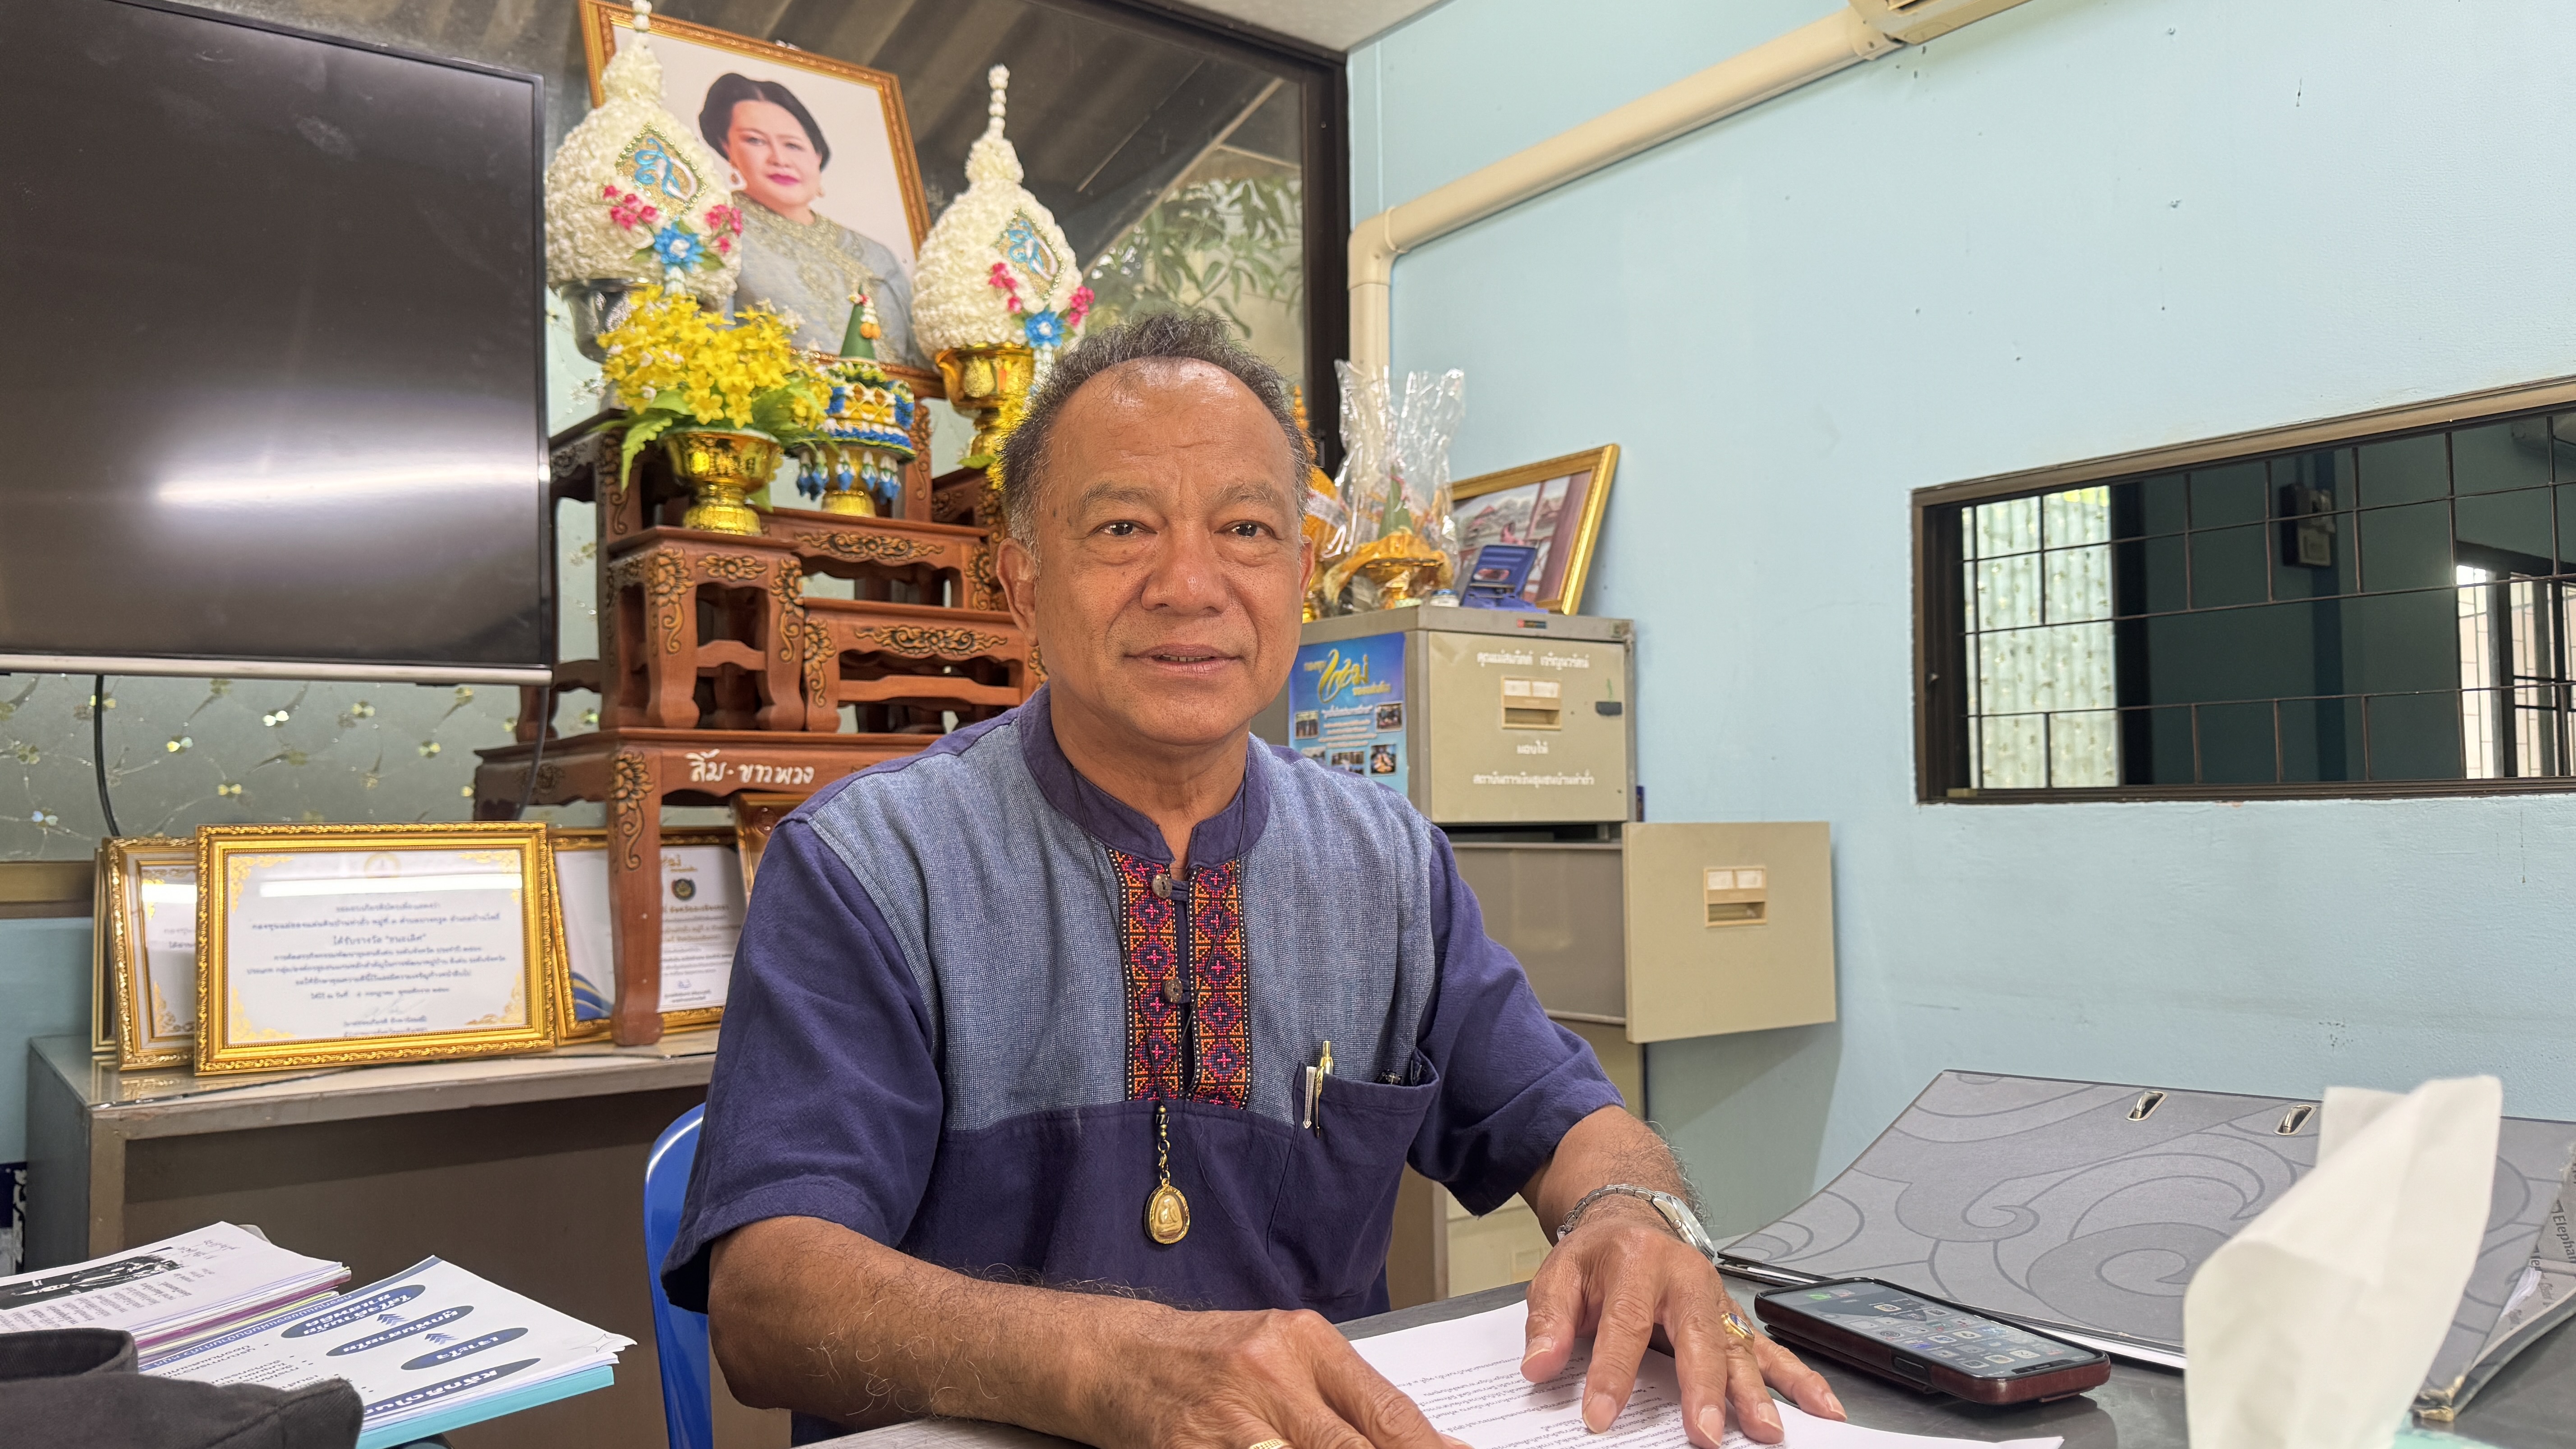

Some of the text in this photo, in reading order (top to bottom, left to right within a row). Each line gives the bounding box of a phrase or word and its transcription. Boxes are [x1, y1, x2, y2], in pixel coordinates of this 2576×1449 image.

[303, 1295, 411, 1335] ใส่ใจต้านภัย
[305, 1293, 391, 1328] ยาเสพติด
[343, 1310, 458, 1352] ผูกพันสายใย
[437, 1336, 499, 1360] เจาะใจ
